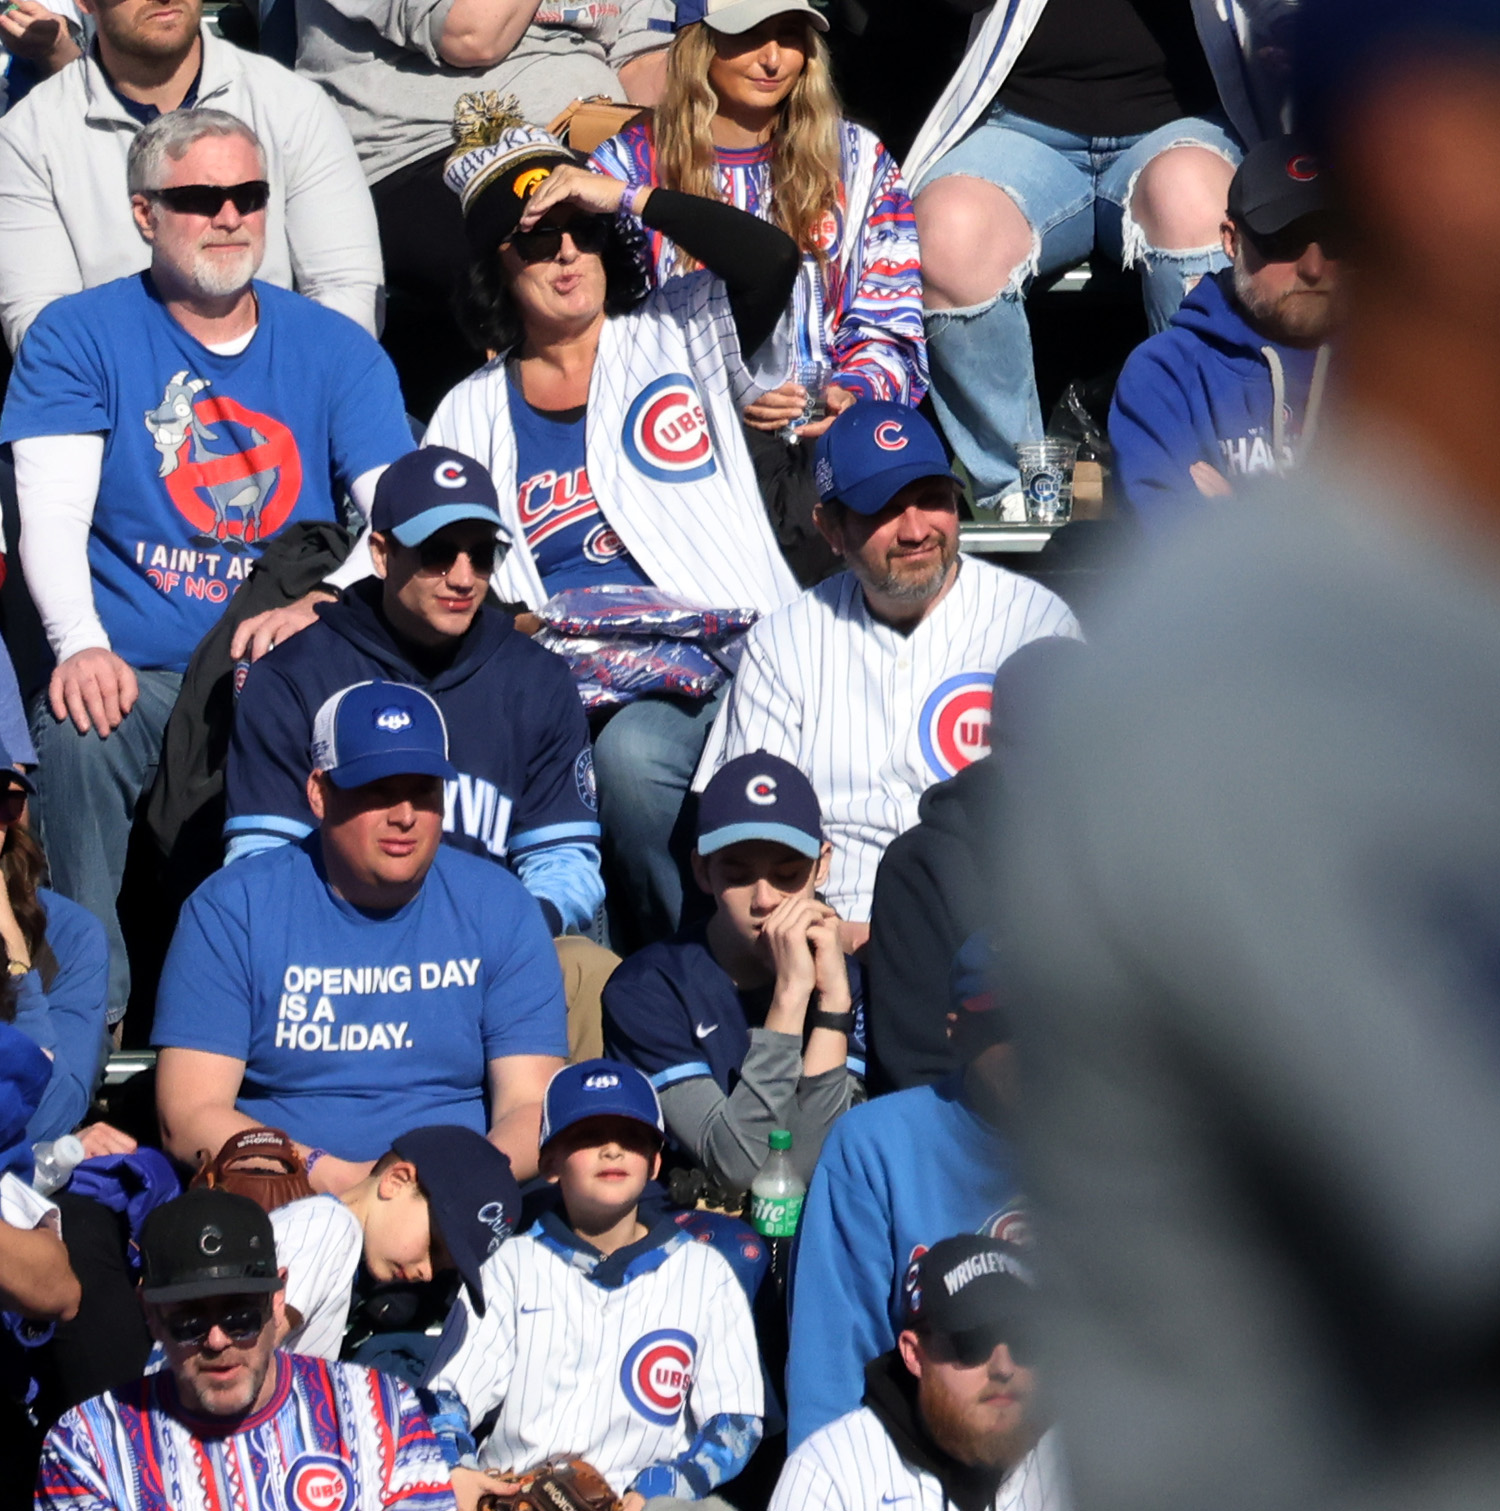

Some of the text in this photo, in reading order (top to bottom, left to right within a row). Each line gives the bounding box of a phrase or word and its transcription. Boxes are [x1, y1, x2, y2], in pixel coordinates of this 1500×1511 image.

[875, 420, 908, 450] C
[433, 459, 467, 489] C
[136, 543, 146, 563] I
[150, 545, 220, 576] AIN'T
[184, 576, 229, 604] NO
[746, 774, 778, 806] C
[284, 957, 481, 996] OPENING DAY
[278, 992, 336, 1023] IS A
[274, 1020, 414, 1052] HOLIDAY.
